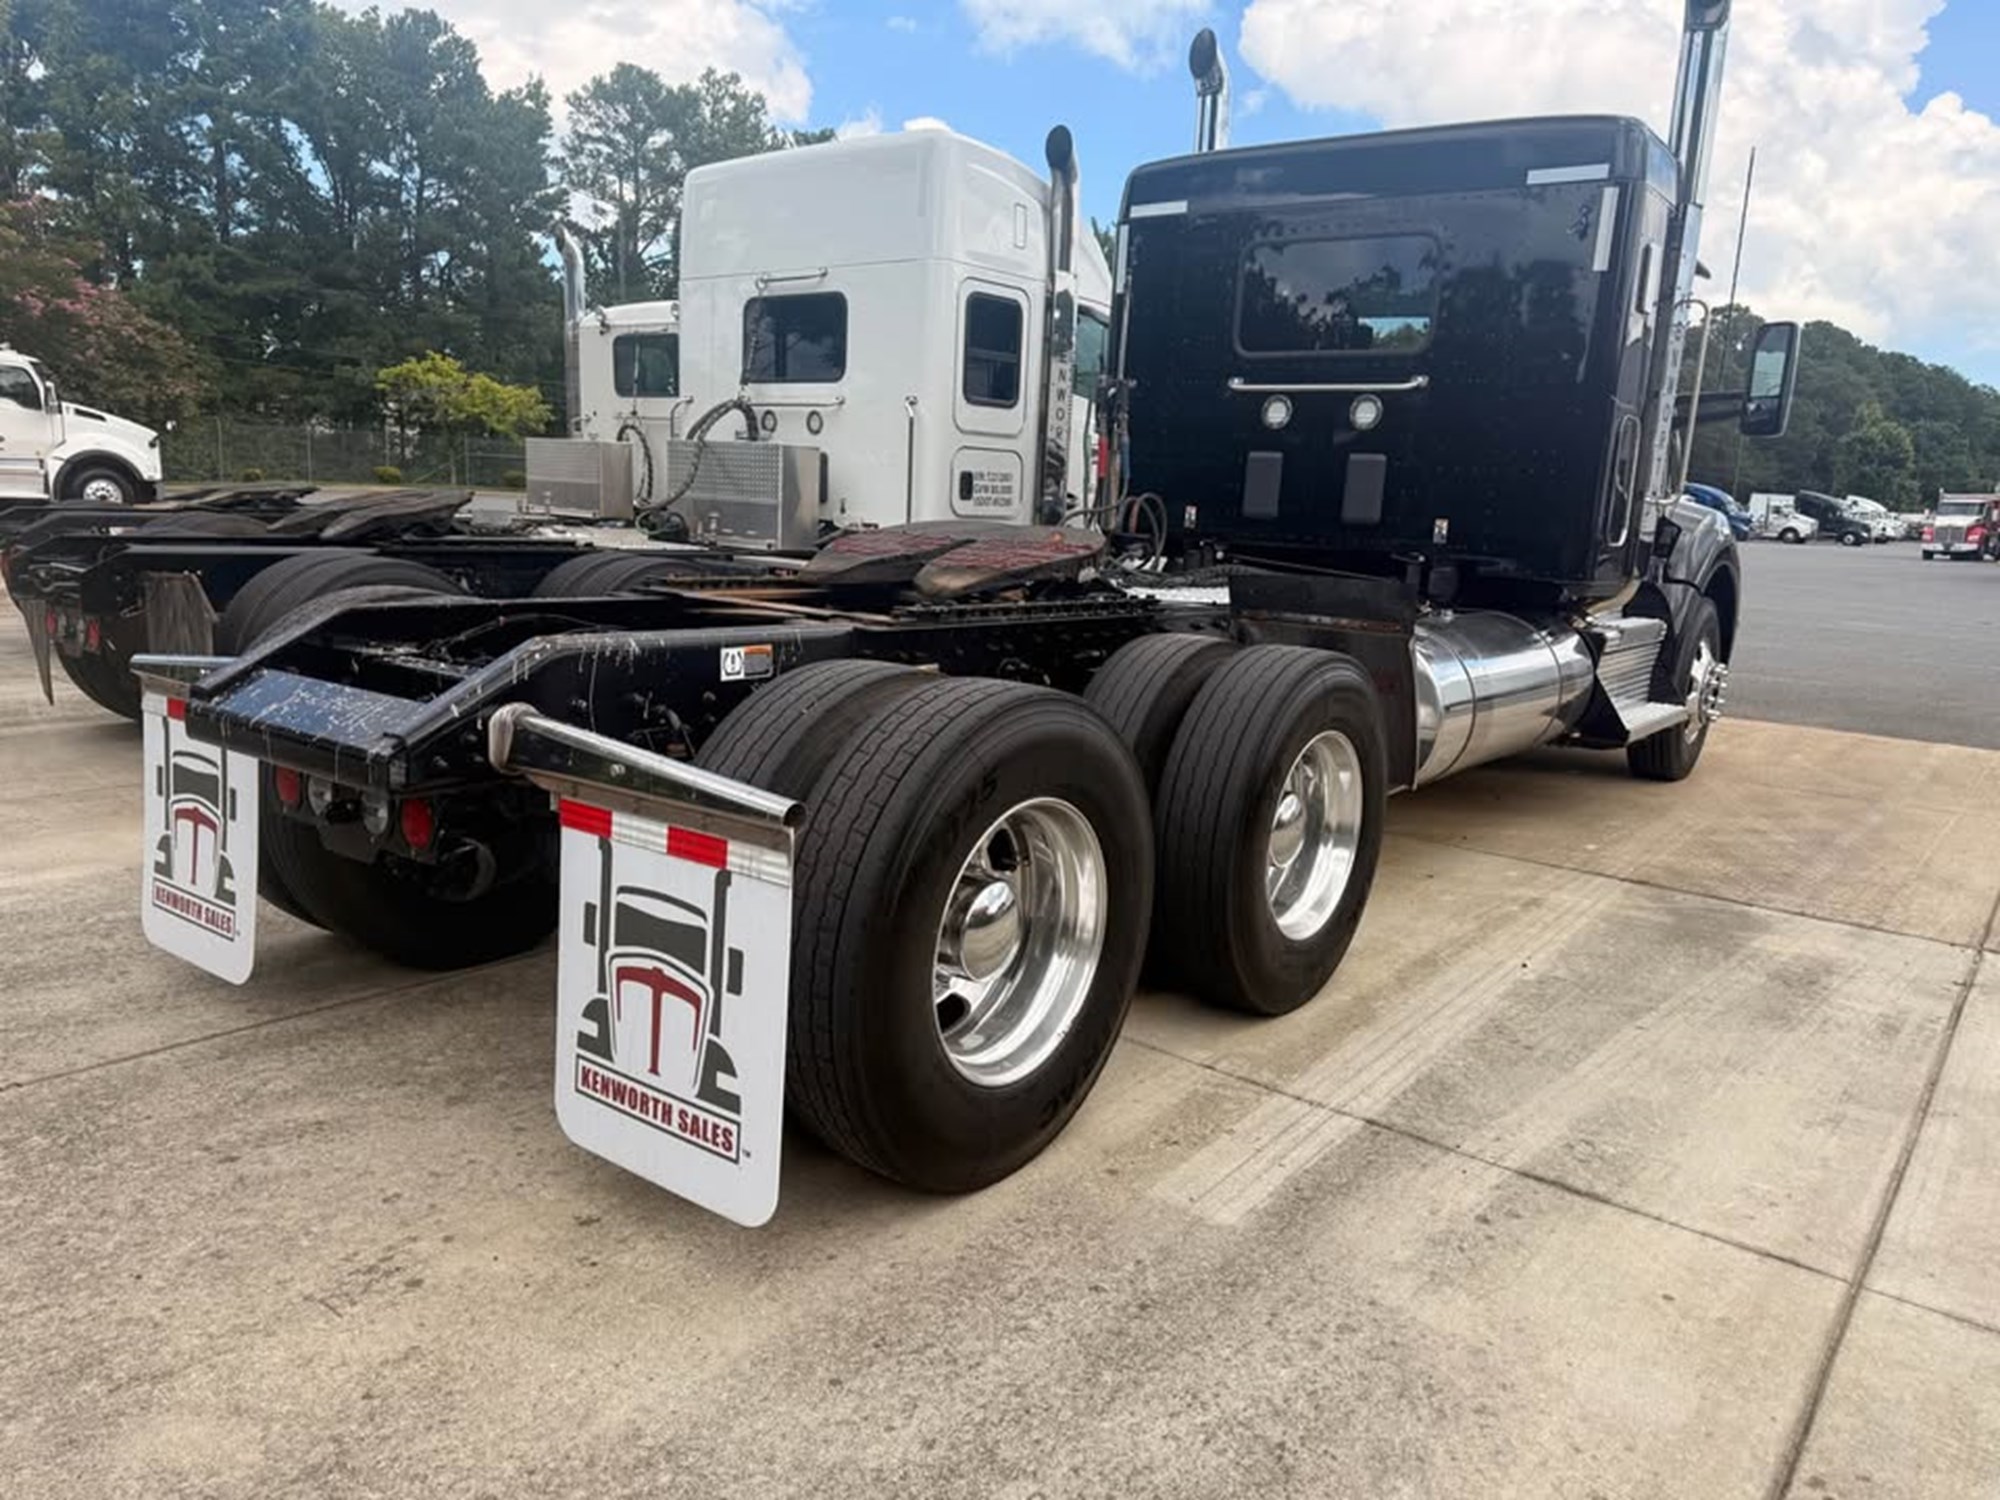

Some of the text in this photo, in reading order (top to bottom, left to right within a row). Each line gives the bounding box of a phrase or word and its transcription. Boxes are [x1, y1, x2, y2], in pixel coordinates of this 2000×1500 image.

[155, 884, 232, 934] KENWORTH SALES
[581, 1065, 673, 1127] KENWORTH
[678, 1108, 734, 1153] SALES
